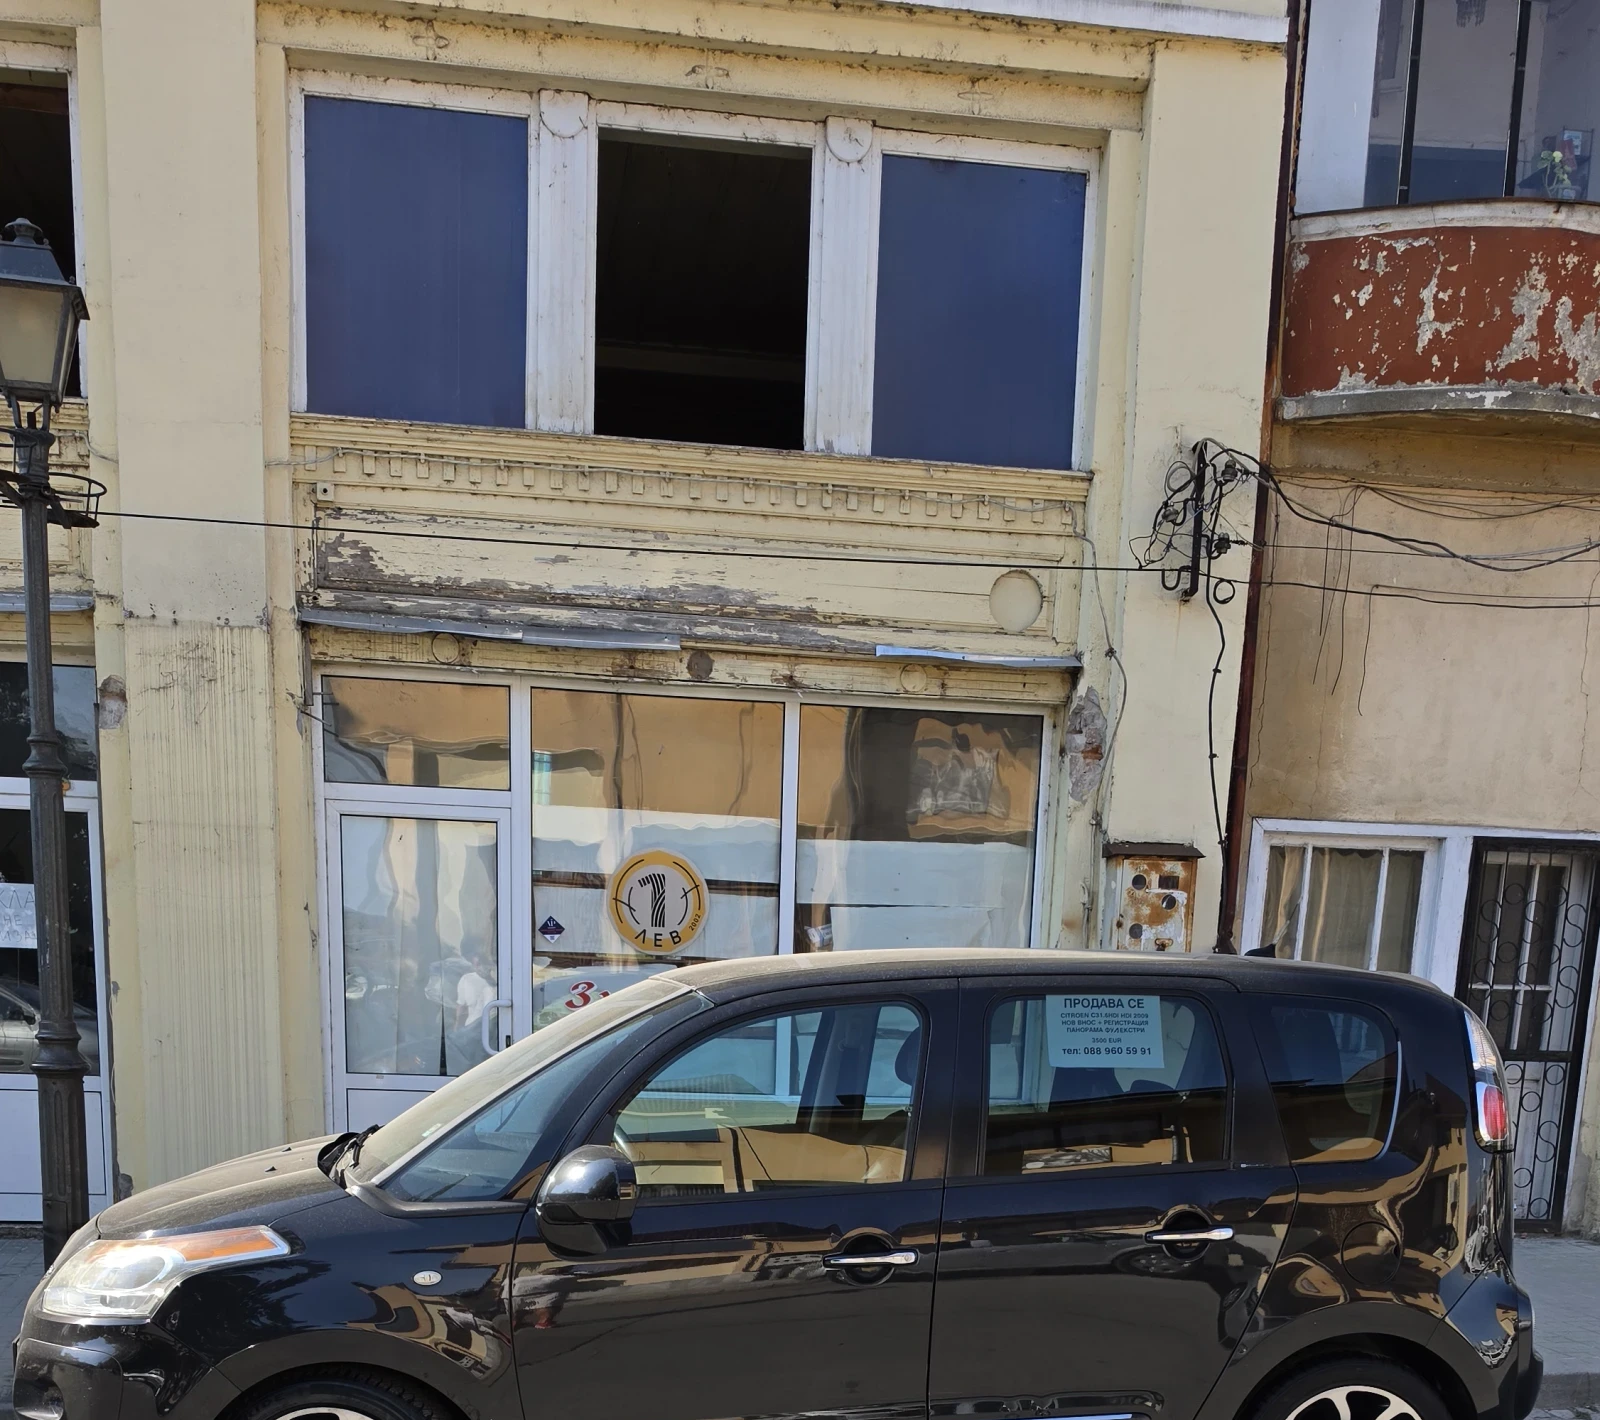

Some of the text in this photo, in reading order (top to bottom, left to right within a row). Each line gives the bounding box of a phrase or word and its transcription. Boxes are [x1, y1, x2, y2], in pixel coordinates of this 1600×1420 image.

[688, 913, 701, 932] 2002
[1063, 998, 1145, 1010] ПРОДАВА СЕ
[1083, 1047, 1102, 1055] 088
[1104, 1047, 1123, 1055] 960
[1126, 1047, 1138, 1055] 59
[1140, 1047, 1151, 1055] 91
